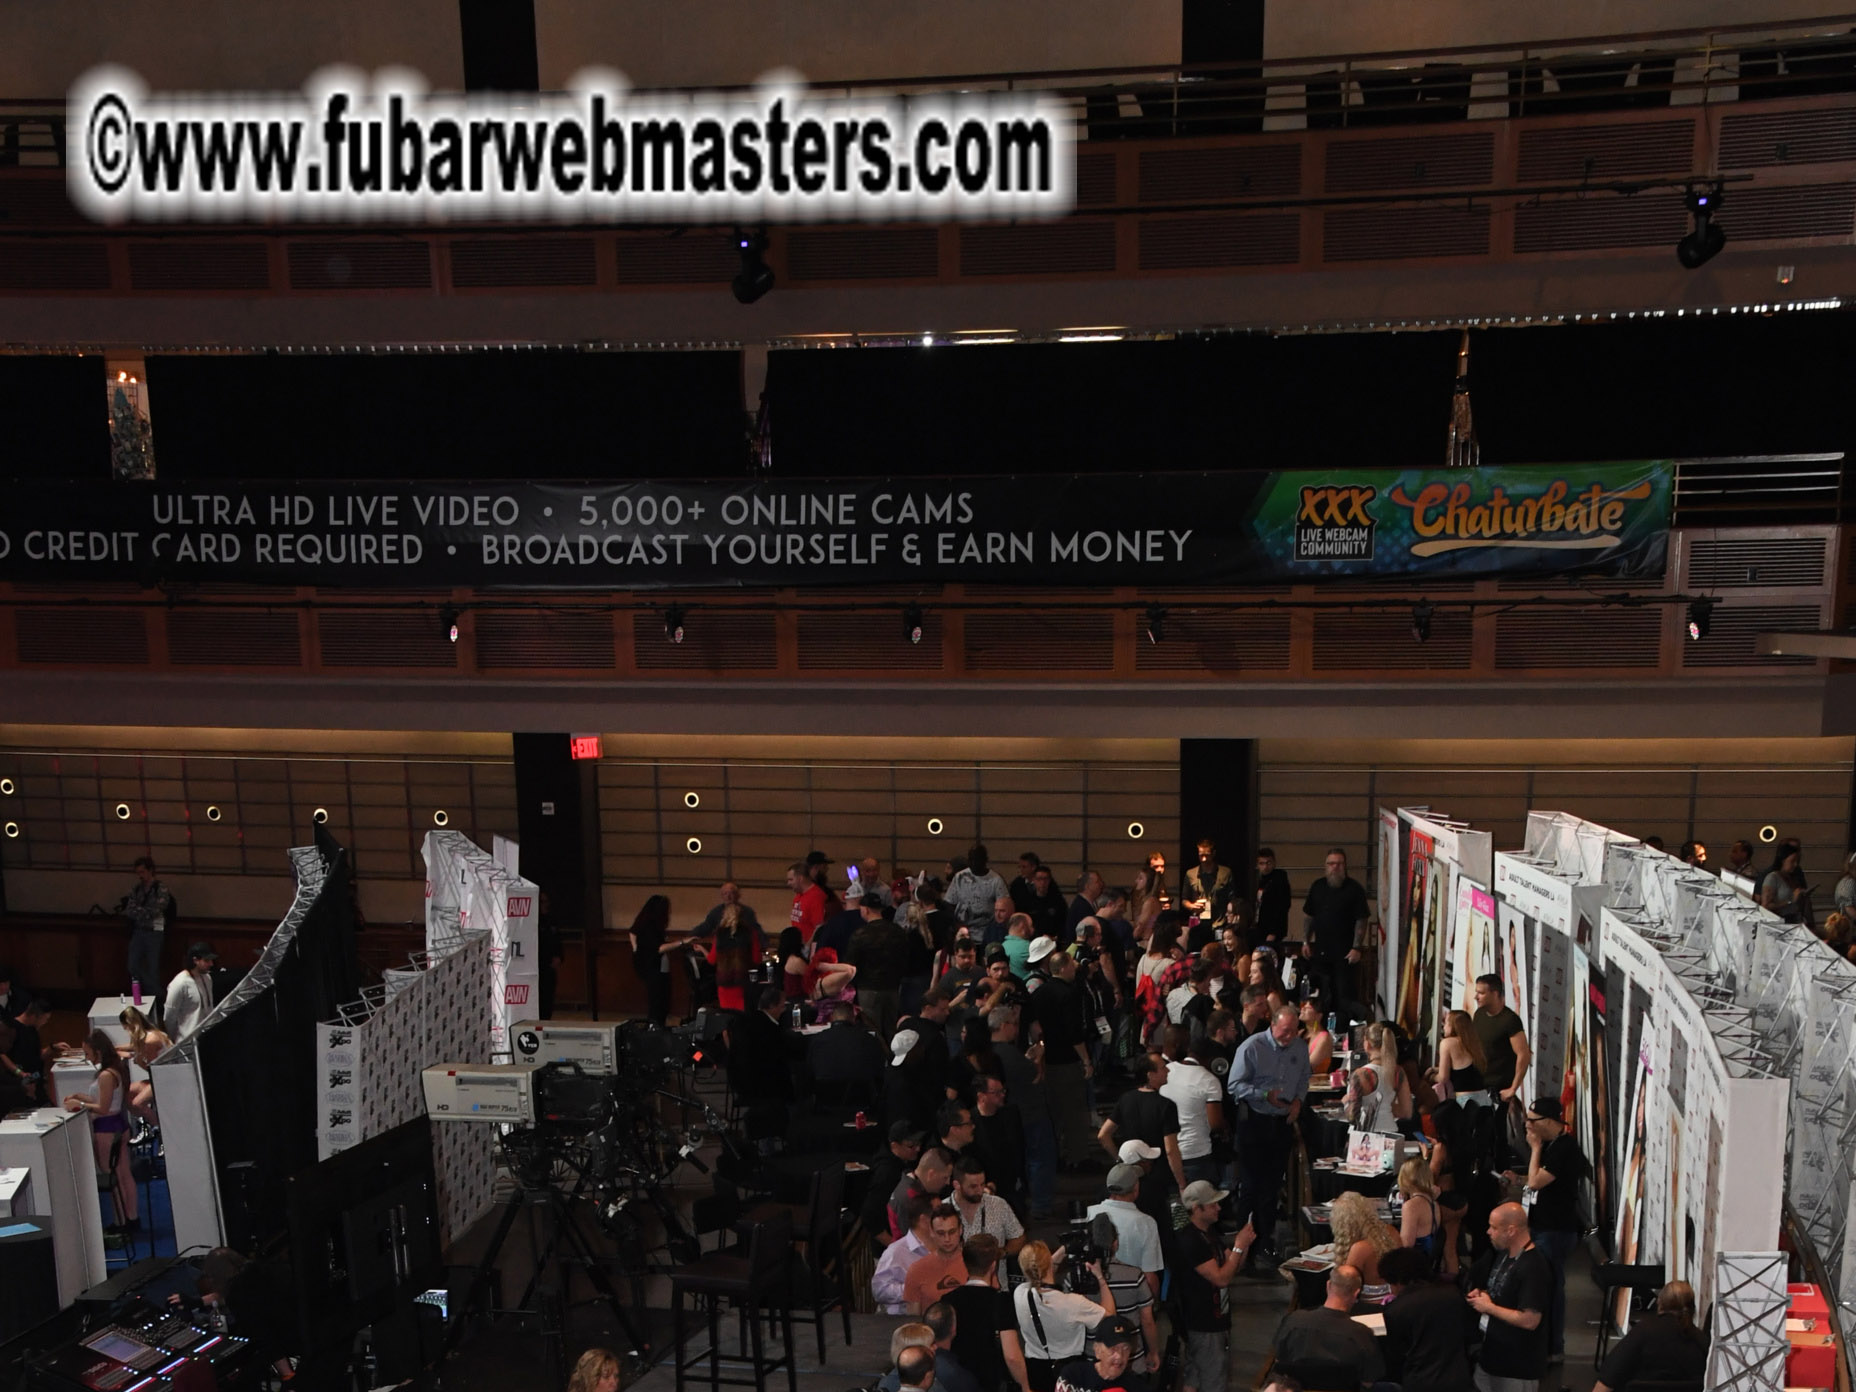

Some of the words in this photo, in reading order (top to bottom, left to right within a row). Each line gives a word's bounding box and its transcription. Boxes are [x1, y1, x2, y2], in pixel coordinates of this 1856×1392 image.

[153, 495, 256, 525] ULTRA
[270, 496, 315, 525] HD
[328, 496, 399, 526] LIVE
[412, 496, 520, 526] VIDEO
[579, 494, 706, 529] 5,000+
[720, 493, 857, 526] ONLINE
[870, 492, 974, 525] CAMS
[1300, 488, 1375, 526] XXX
[1390, 480, 1652, 540] Chaturbate
[1301, 528, 1323, 542] LIVE
[1325, 527, 1368, 542] WEBCAM
[24, 531, 139, 561] CREDIT
[152, 532, 241, 562] CARD
[255, 533, 423, 564] REQUIRED
[482, 533, 690, 565] BROADCAST
[702, 532, 889, 565] YOURSELF
[901, 533, 922, 566] &
[936, 532, 1034, 564] EARN
[1050, 529, 1193, 563] MONEY
[1300, 541, 1367, 556] COMMUNITY
[576, 737, 598, 759] EXIT
[508, 898, 530, 917] AVN
[505, 986, 529, 1004] AVN
